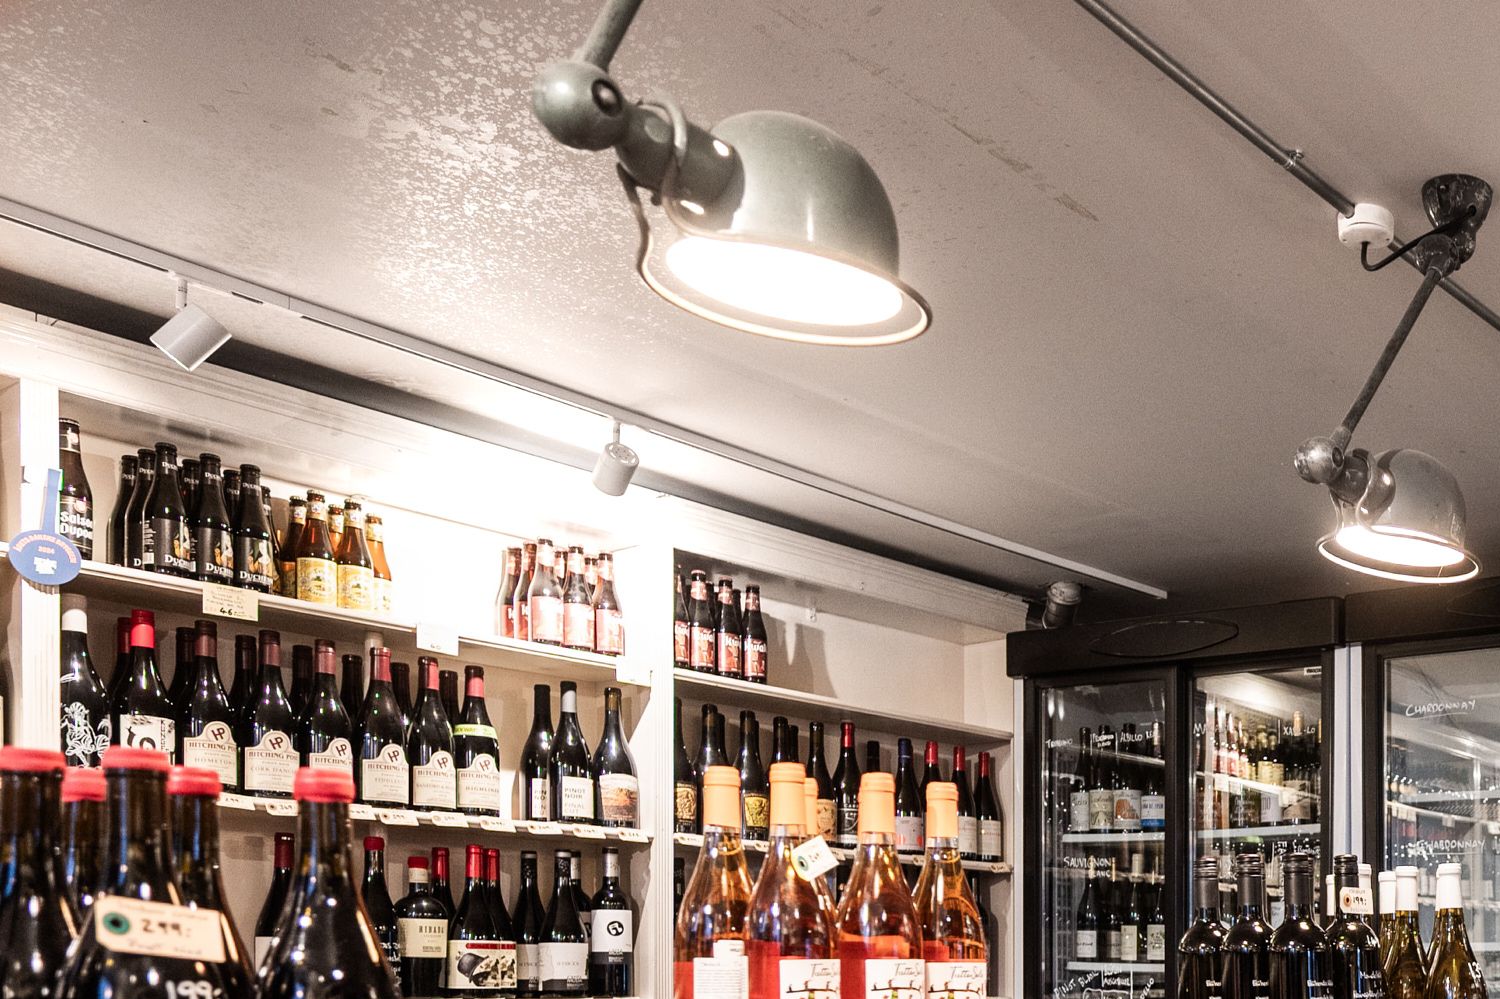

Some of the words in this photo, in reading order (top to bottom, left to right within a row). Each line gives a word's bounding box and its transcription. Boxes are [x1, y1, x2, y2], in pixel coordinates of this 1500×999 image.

[1405, 699, 1476, 717] CHARDONNAY
[269, 736, 284, 751] HP
[387, 750, 400, 763] HP
[436, 756, 449, 770] HP
[1063, 855, 1112, 869] SAUVIGNON
